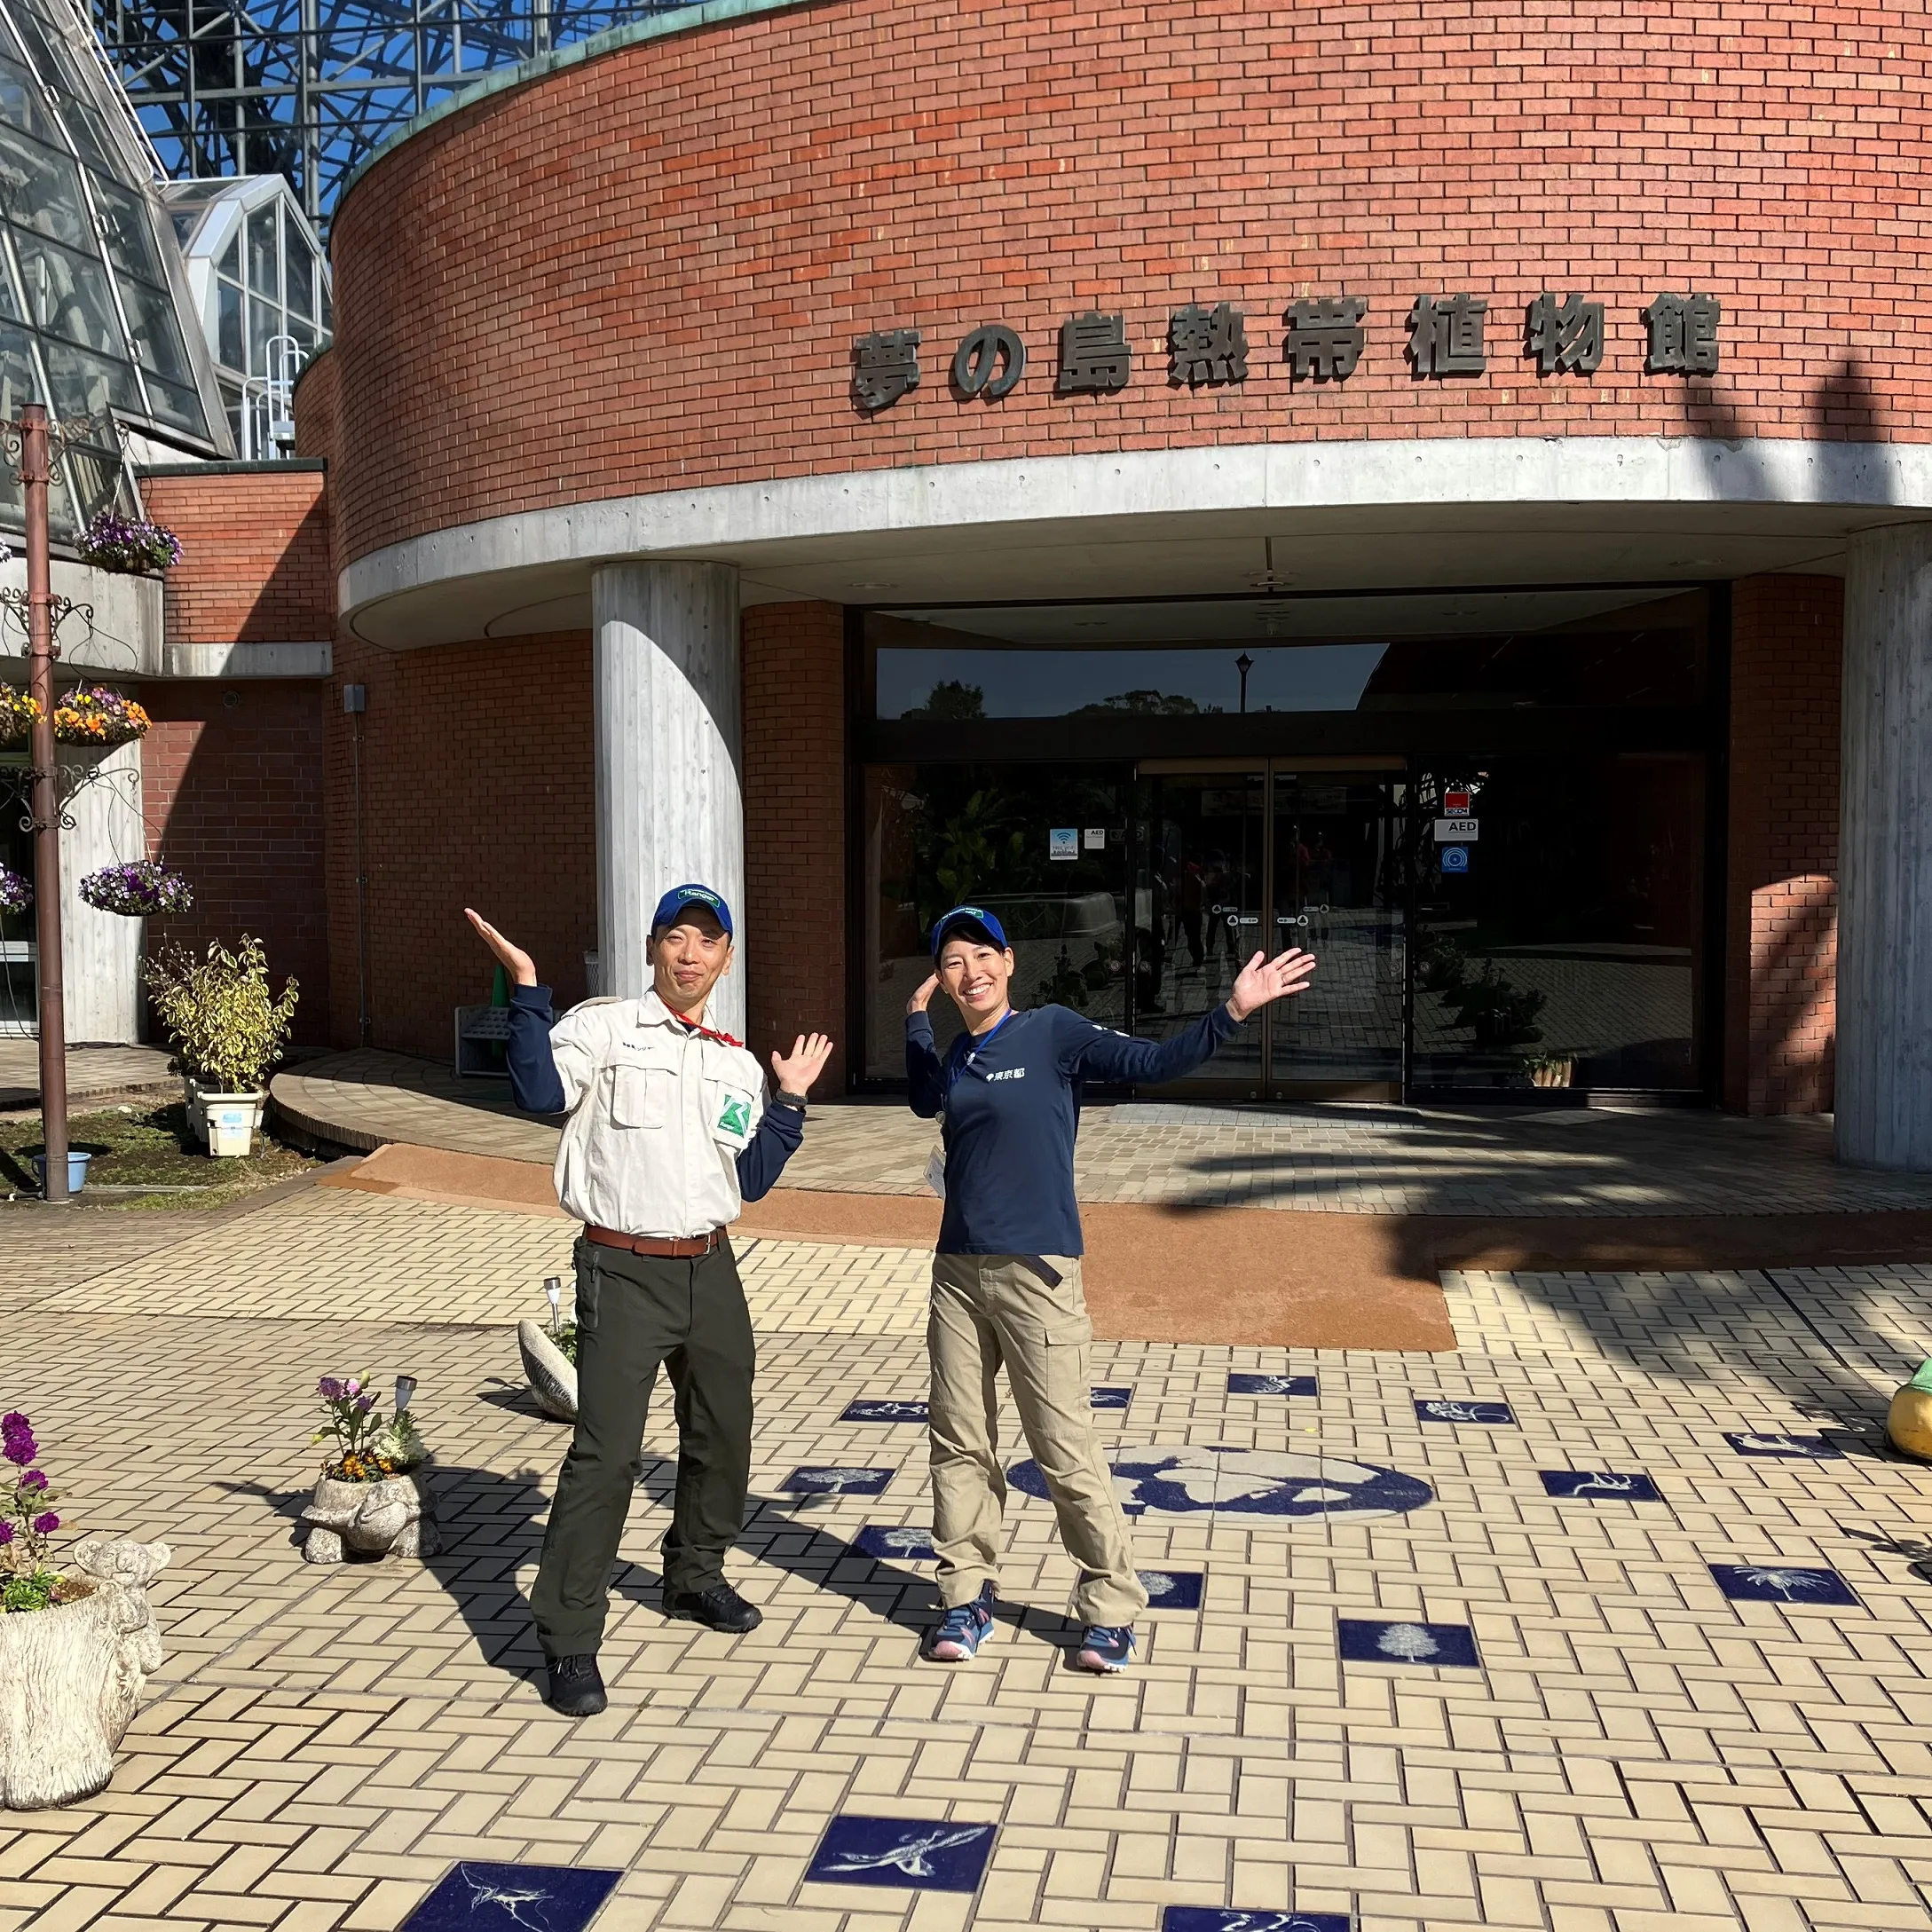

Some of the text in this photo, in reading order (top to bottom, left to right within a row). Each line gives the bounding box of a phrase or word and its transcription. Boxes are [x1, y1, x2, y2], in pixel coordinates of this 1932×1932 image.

[855, 292, 1719, 410] 夢の島熱帯植物館
[1448, 822, 1477, 832] AED
[993, 1068, 1025, 1081] 東京都
